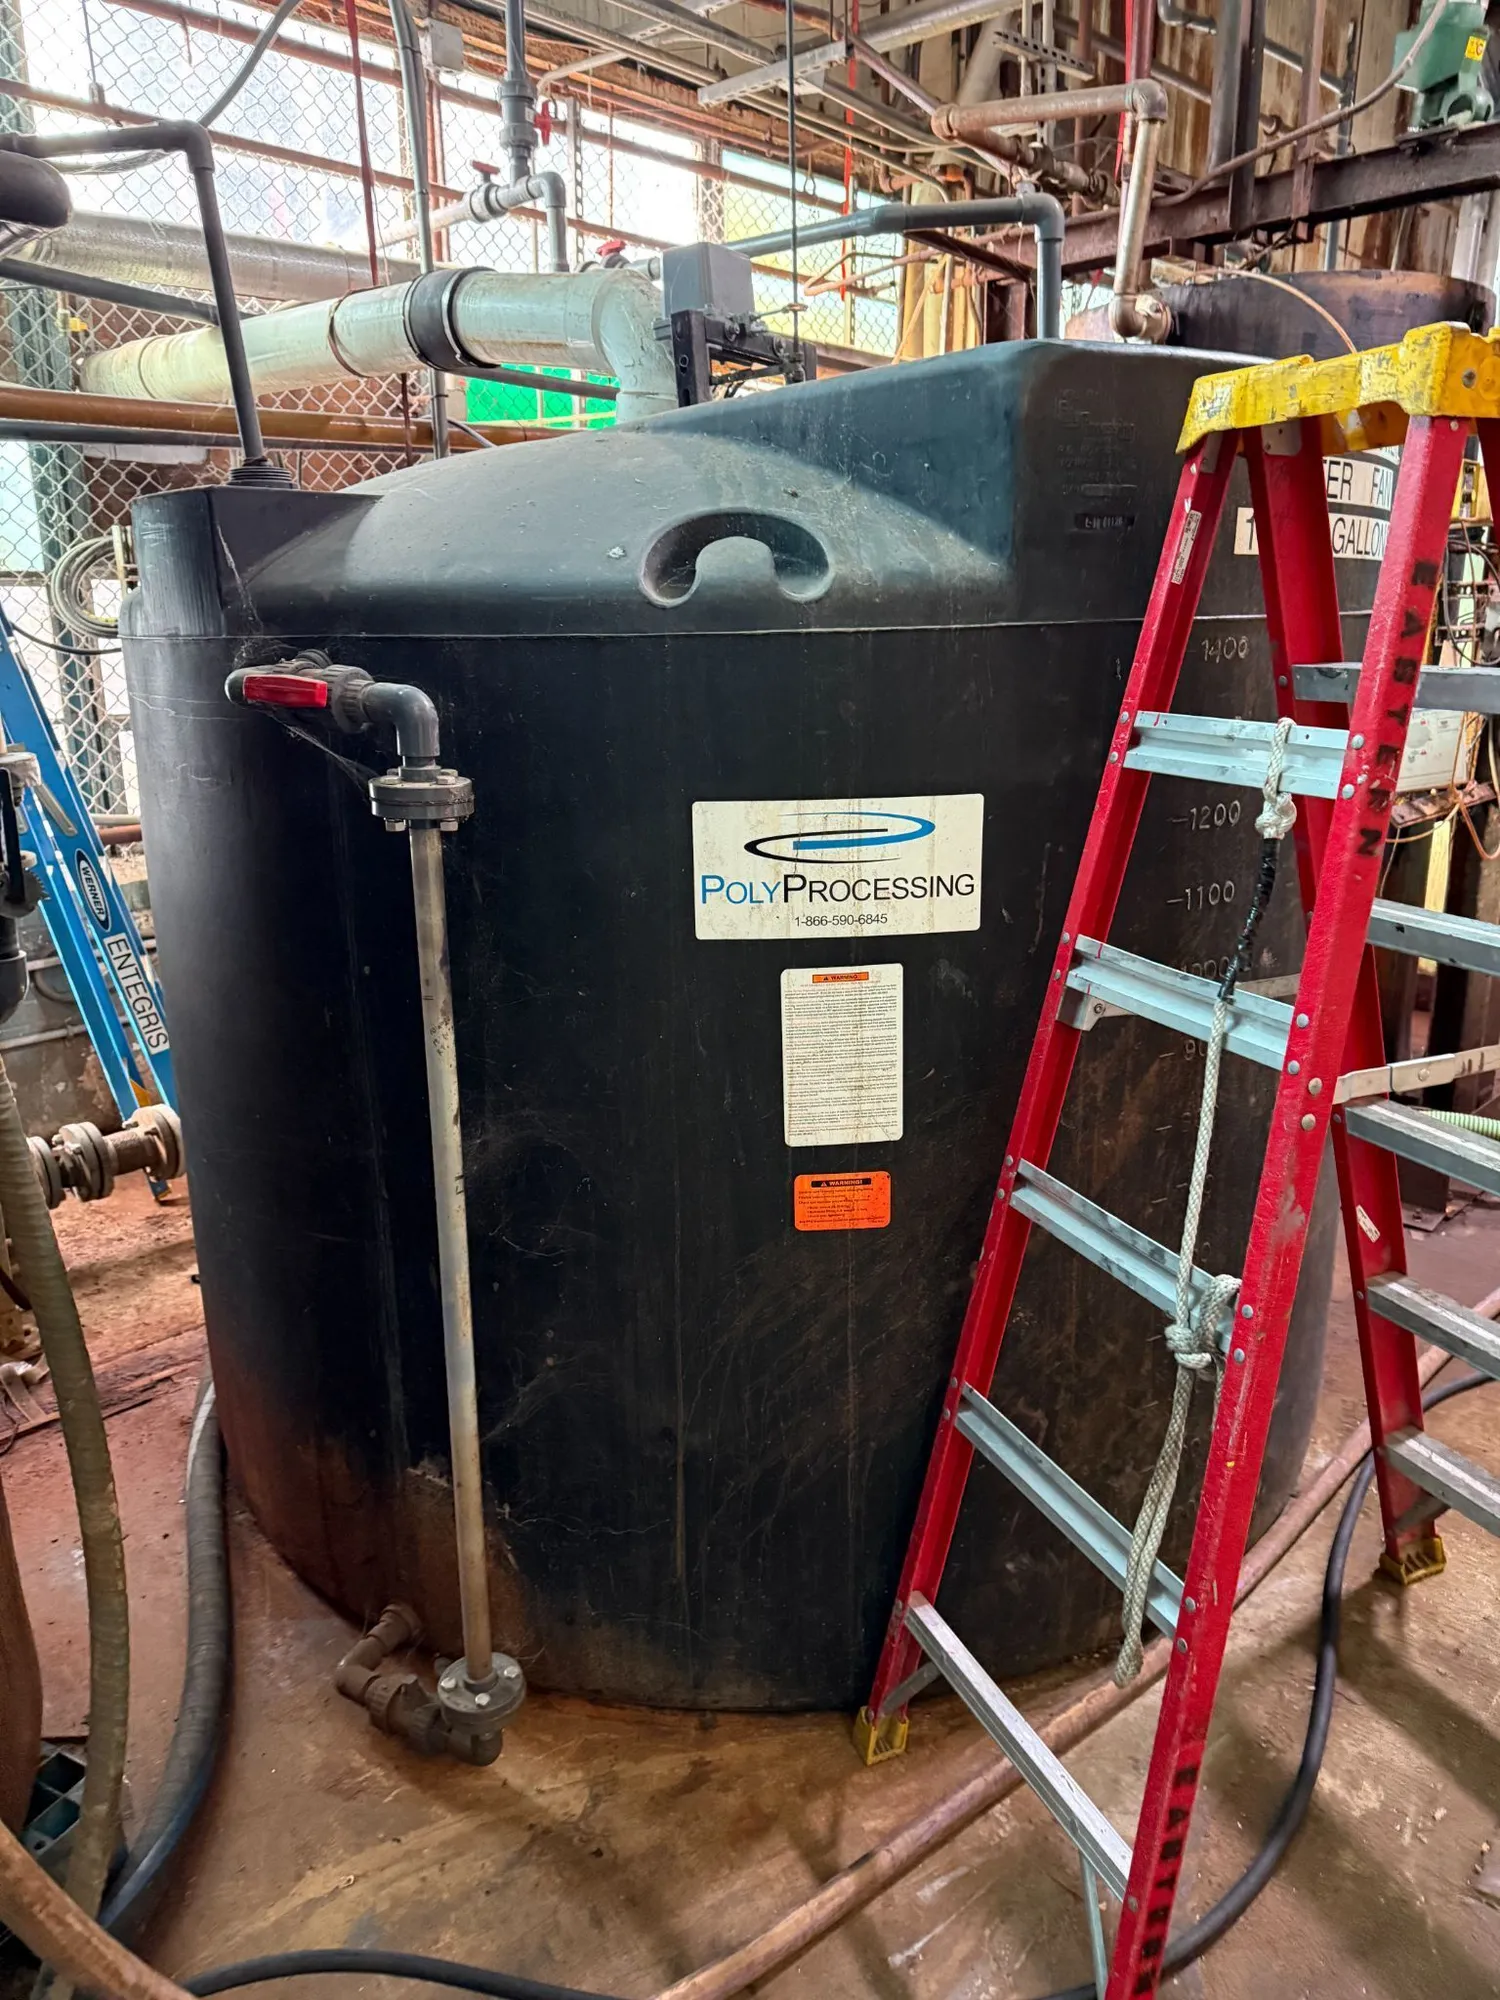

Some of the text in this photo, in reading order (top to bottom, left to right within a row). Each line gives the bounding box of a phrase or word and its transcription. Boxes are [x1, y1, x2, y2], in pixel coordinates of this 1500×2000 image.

[1323, 459, 1354, 501] ER
[1201, 635, 1249, 664] 1400
[81, 866, 105, 917] WERNER
[794, 914, 888, 927] 1-866-590-6845
[107, 938, 169, 1049] ENTEGRIS
